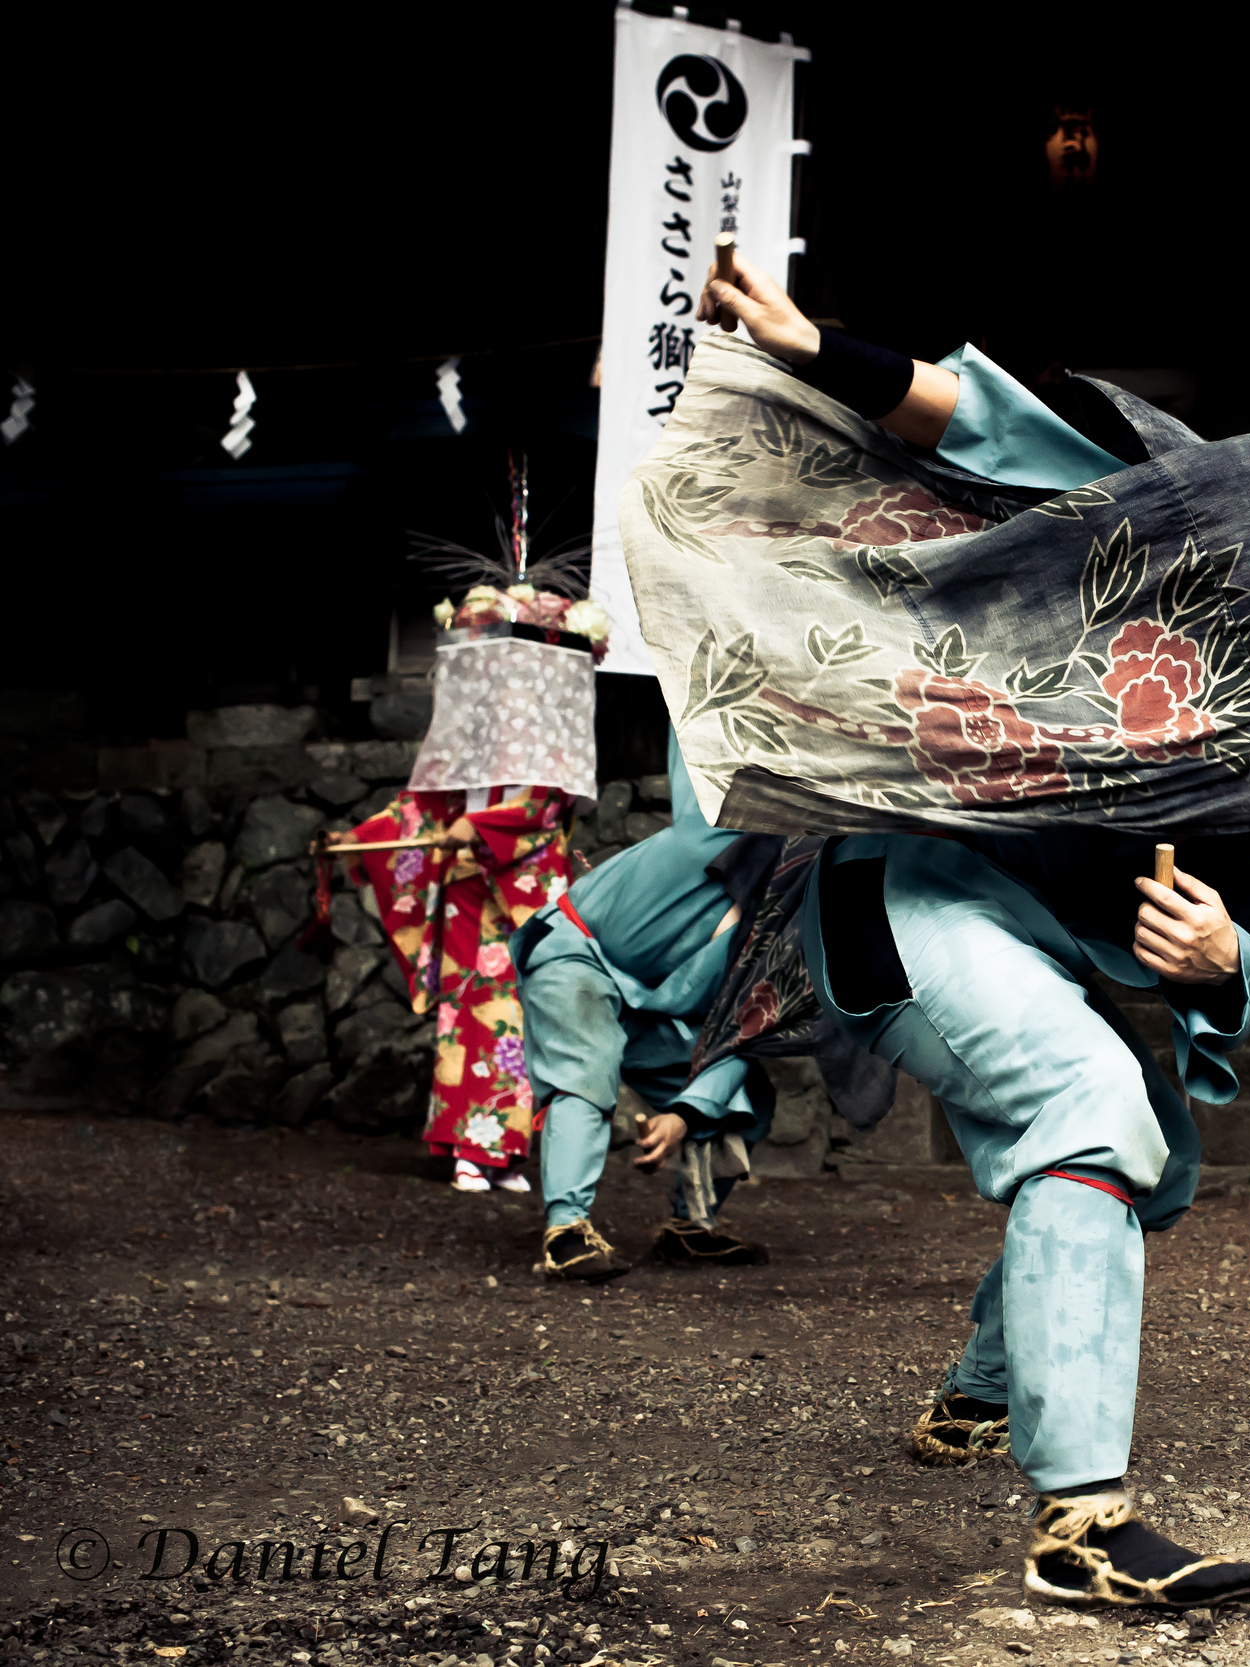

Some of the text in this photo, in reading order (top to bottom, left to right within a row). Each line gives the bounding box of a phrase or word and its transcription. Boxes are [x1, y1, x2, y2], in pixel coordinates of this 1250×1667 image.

[647, 155, 696, 427] ささら獅子
[720, 169, 743, 249] 山梨県
